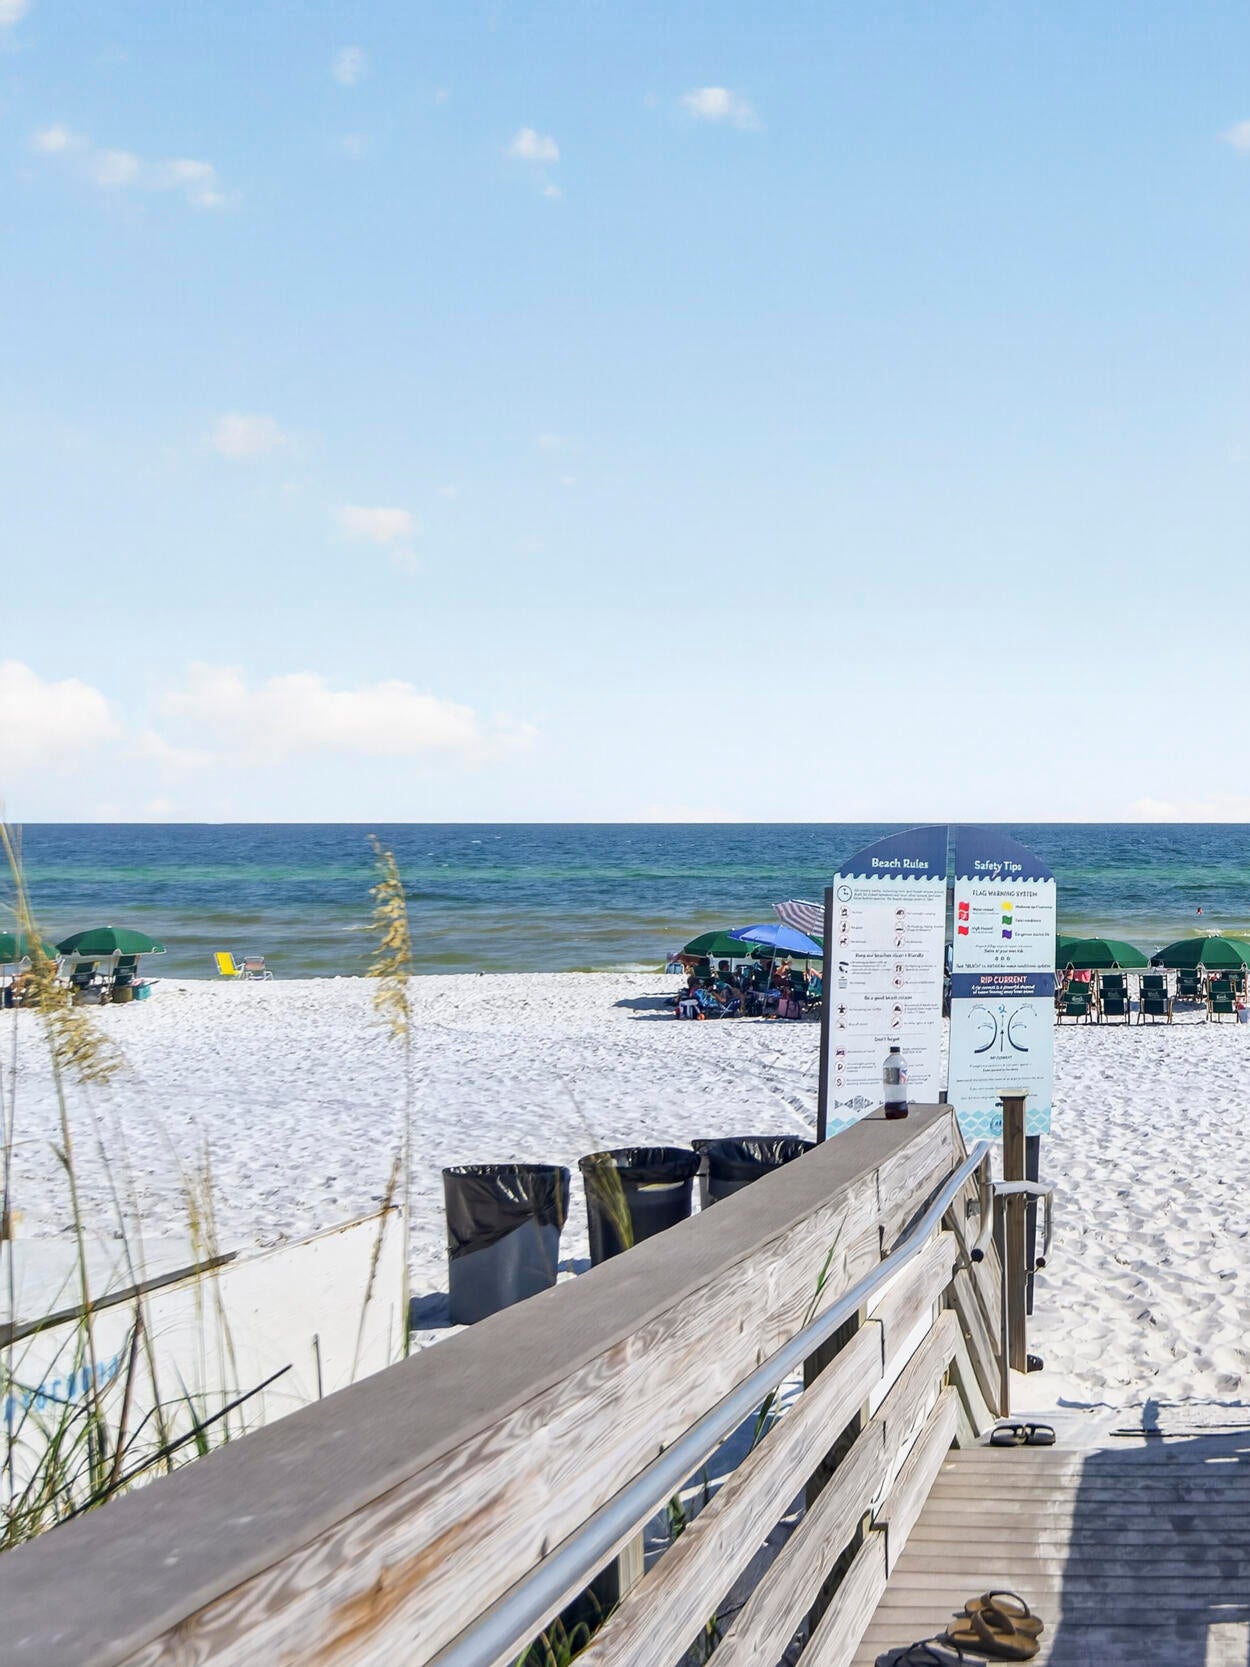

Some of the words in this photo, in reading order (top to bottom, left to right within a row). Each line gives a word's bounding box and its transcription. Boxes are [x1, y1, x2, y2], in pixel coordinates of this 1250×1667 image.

[871, 857, 901, 868] Beach
[903, 858, 929, 869] Rules
[974, 860, 1003, 872] Safety
[1003, 861, 1022, 873] Tips
[972, 889, 987, 897] FLAG
[988, 889, 1015, 897] WARNING
[980, 975, 993, 984] RIP
[994, 975, 1027, 984] CURRENT
